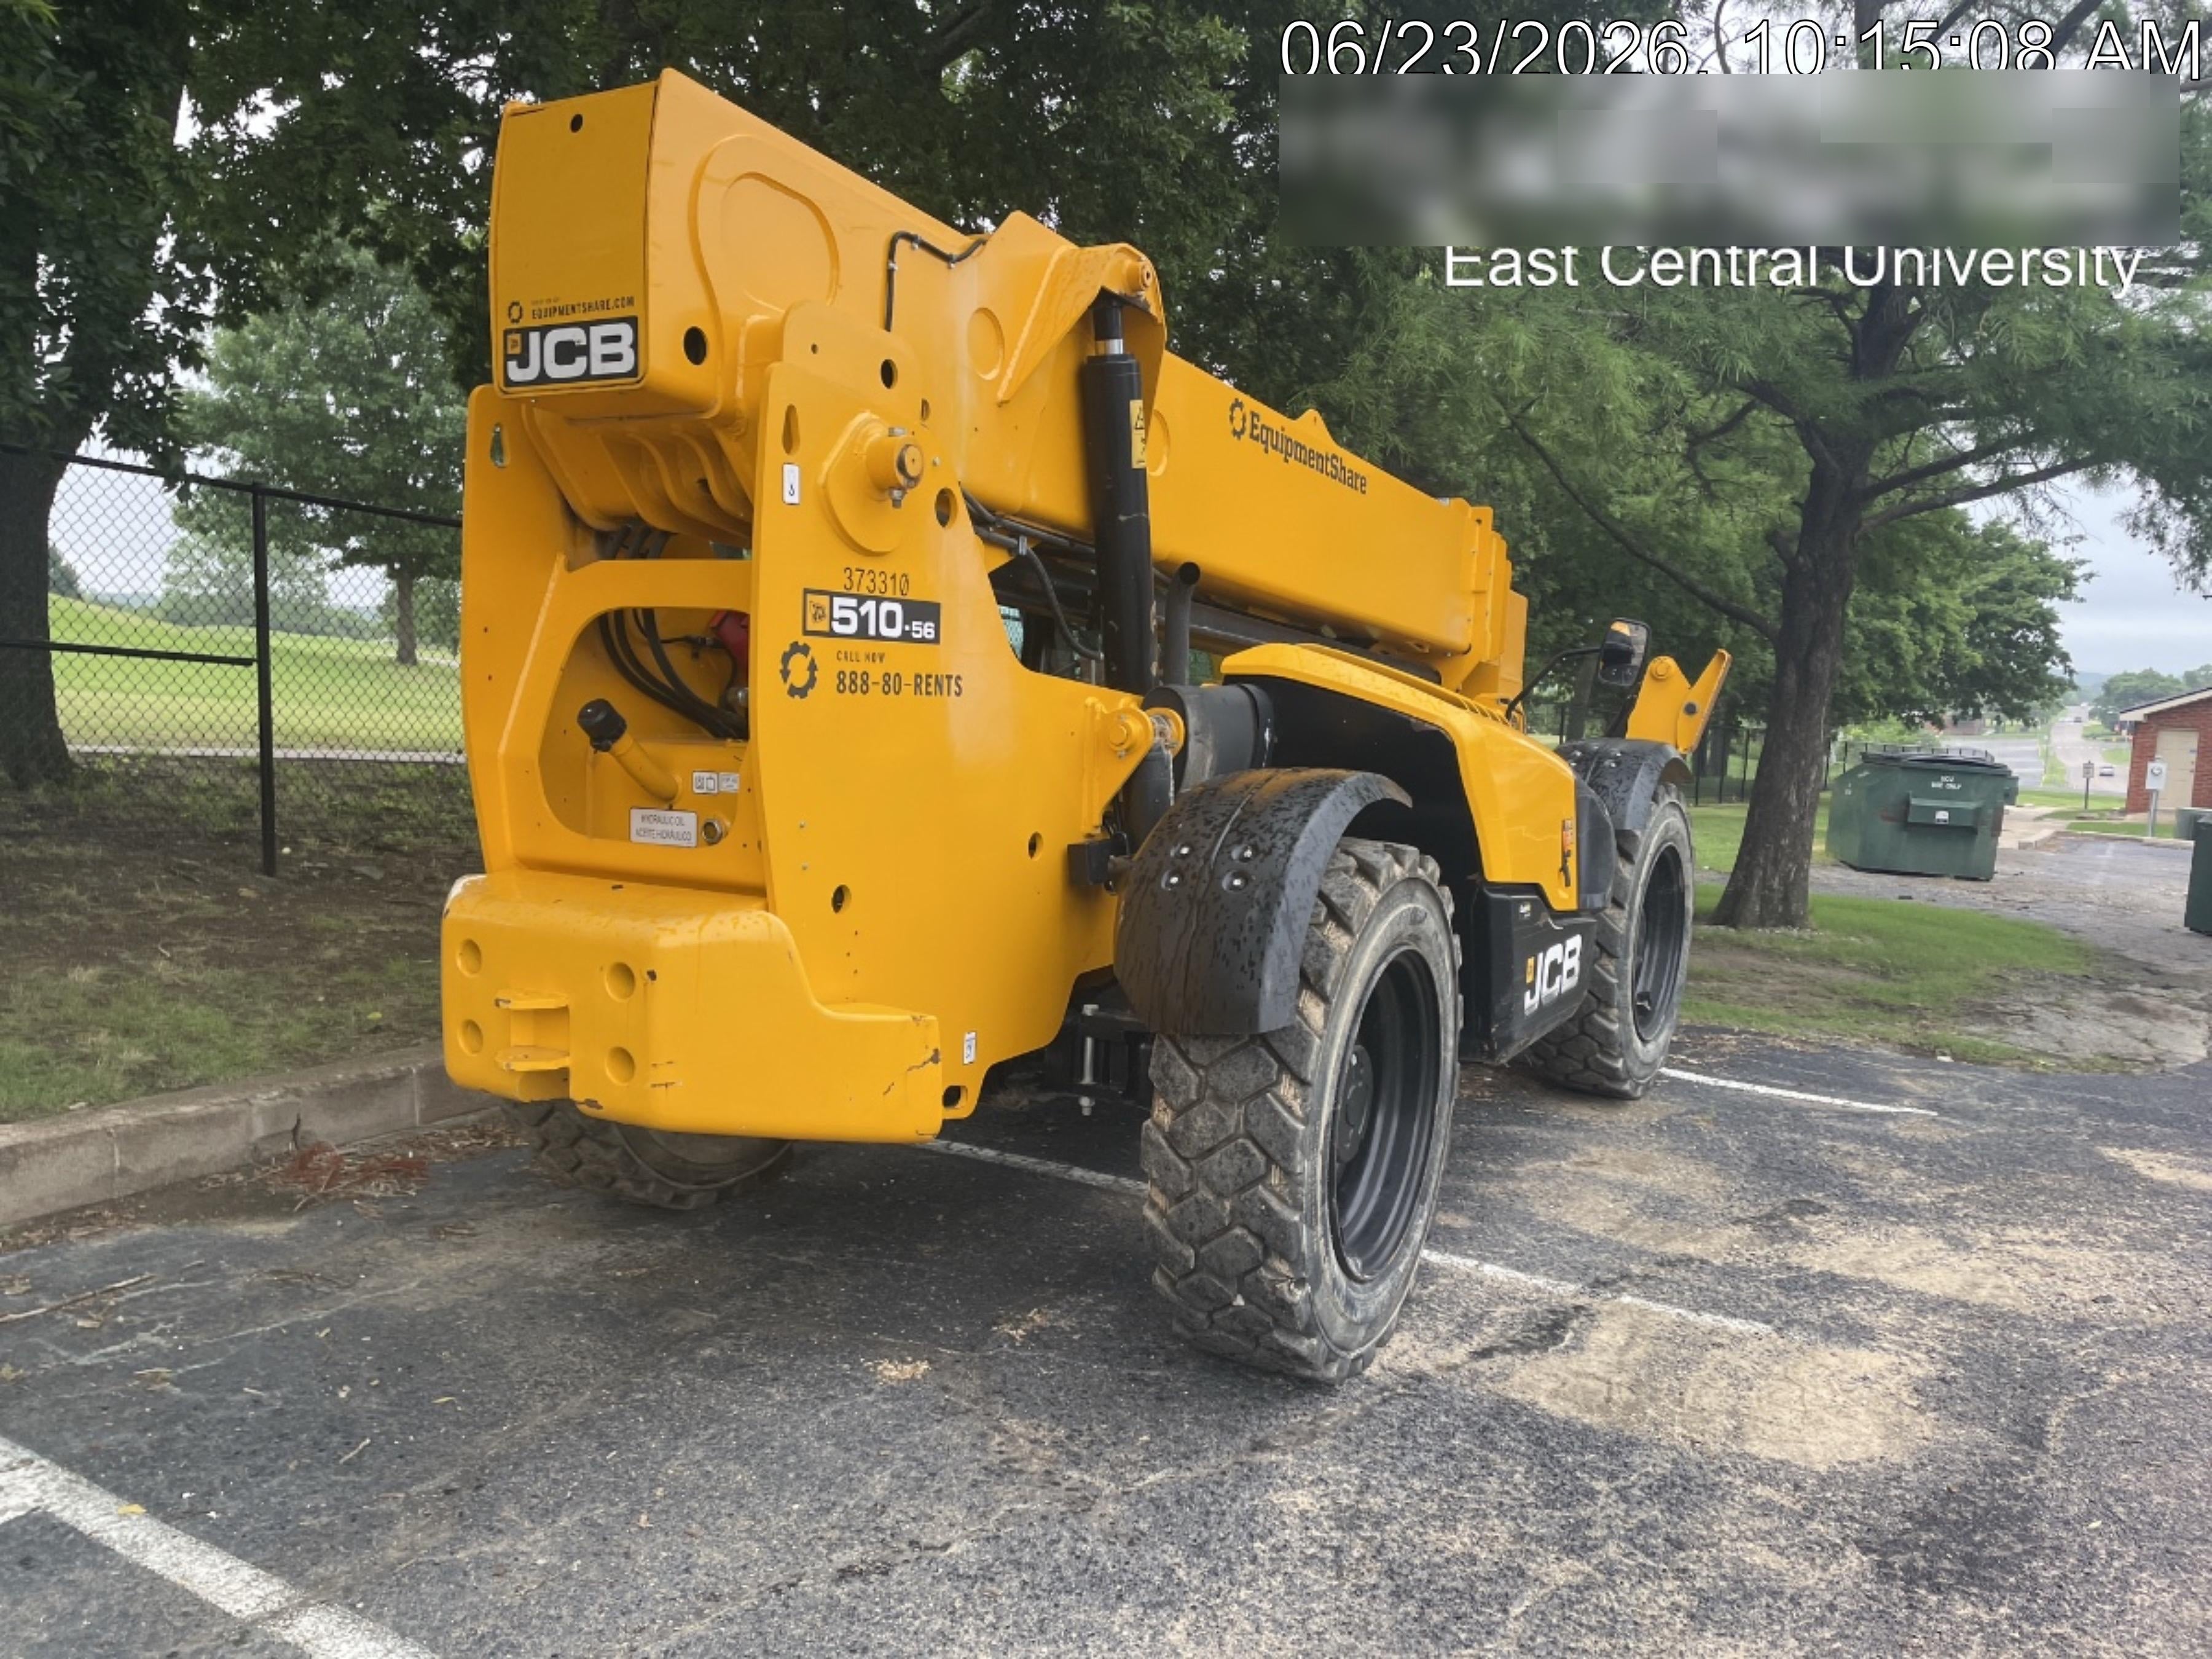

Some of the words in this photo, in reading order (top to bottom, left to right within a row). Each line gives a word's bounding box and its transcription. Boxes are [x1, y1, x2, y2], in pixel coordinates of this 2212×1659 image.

[532, 296, 634, 320] EQUIPMENTSHARE.COM
[506, 321, 635, 383] JCB
[1249, 410, 1367, 495] EquipmentShare
[843, 567, 910, 597] 373310
[836, 649, 860, 662] CALL
[865, 652, 885, 664] NOW
[836, 670, 963, 697] 888-80-RENTS
[1524, 933, 1582, 1016] JCB
